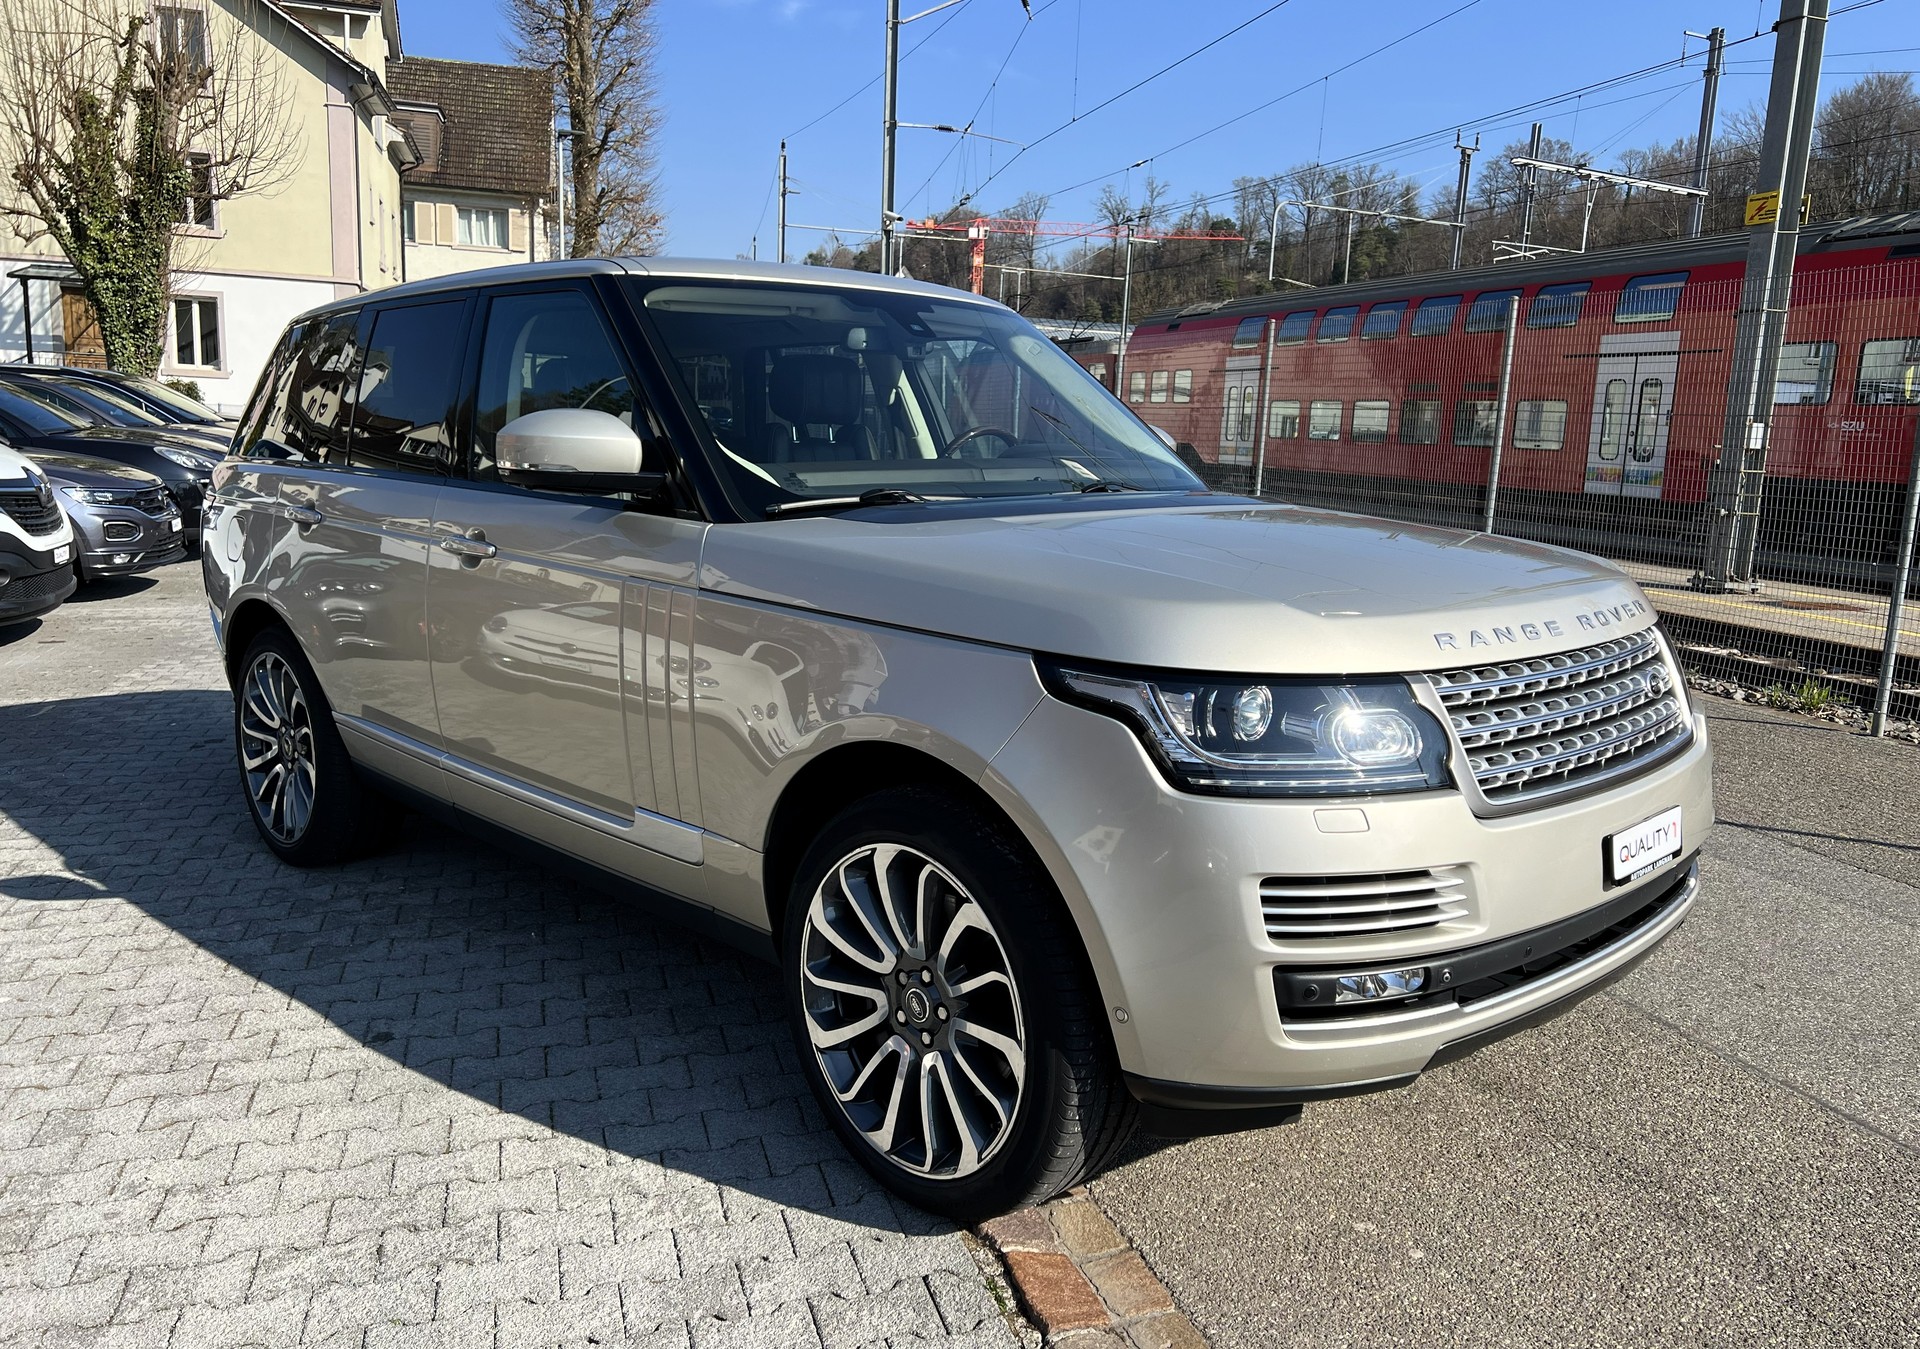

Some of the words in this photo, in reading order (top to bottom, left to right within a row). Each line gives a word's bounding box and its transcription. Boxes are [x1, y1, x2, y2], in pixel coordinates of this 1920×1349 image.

[1841, 421, 1865, 431] SZU
[1434, 619, 1565, 651] RANGE
[1576, 599, 1647, 631] ROVER
[1619, 823, 1671, 863] QUALITY
[1672, 821, 1677, 838] 1
